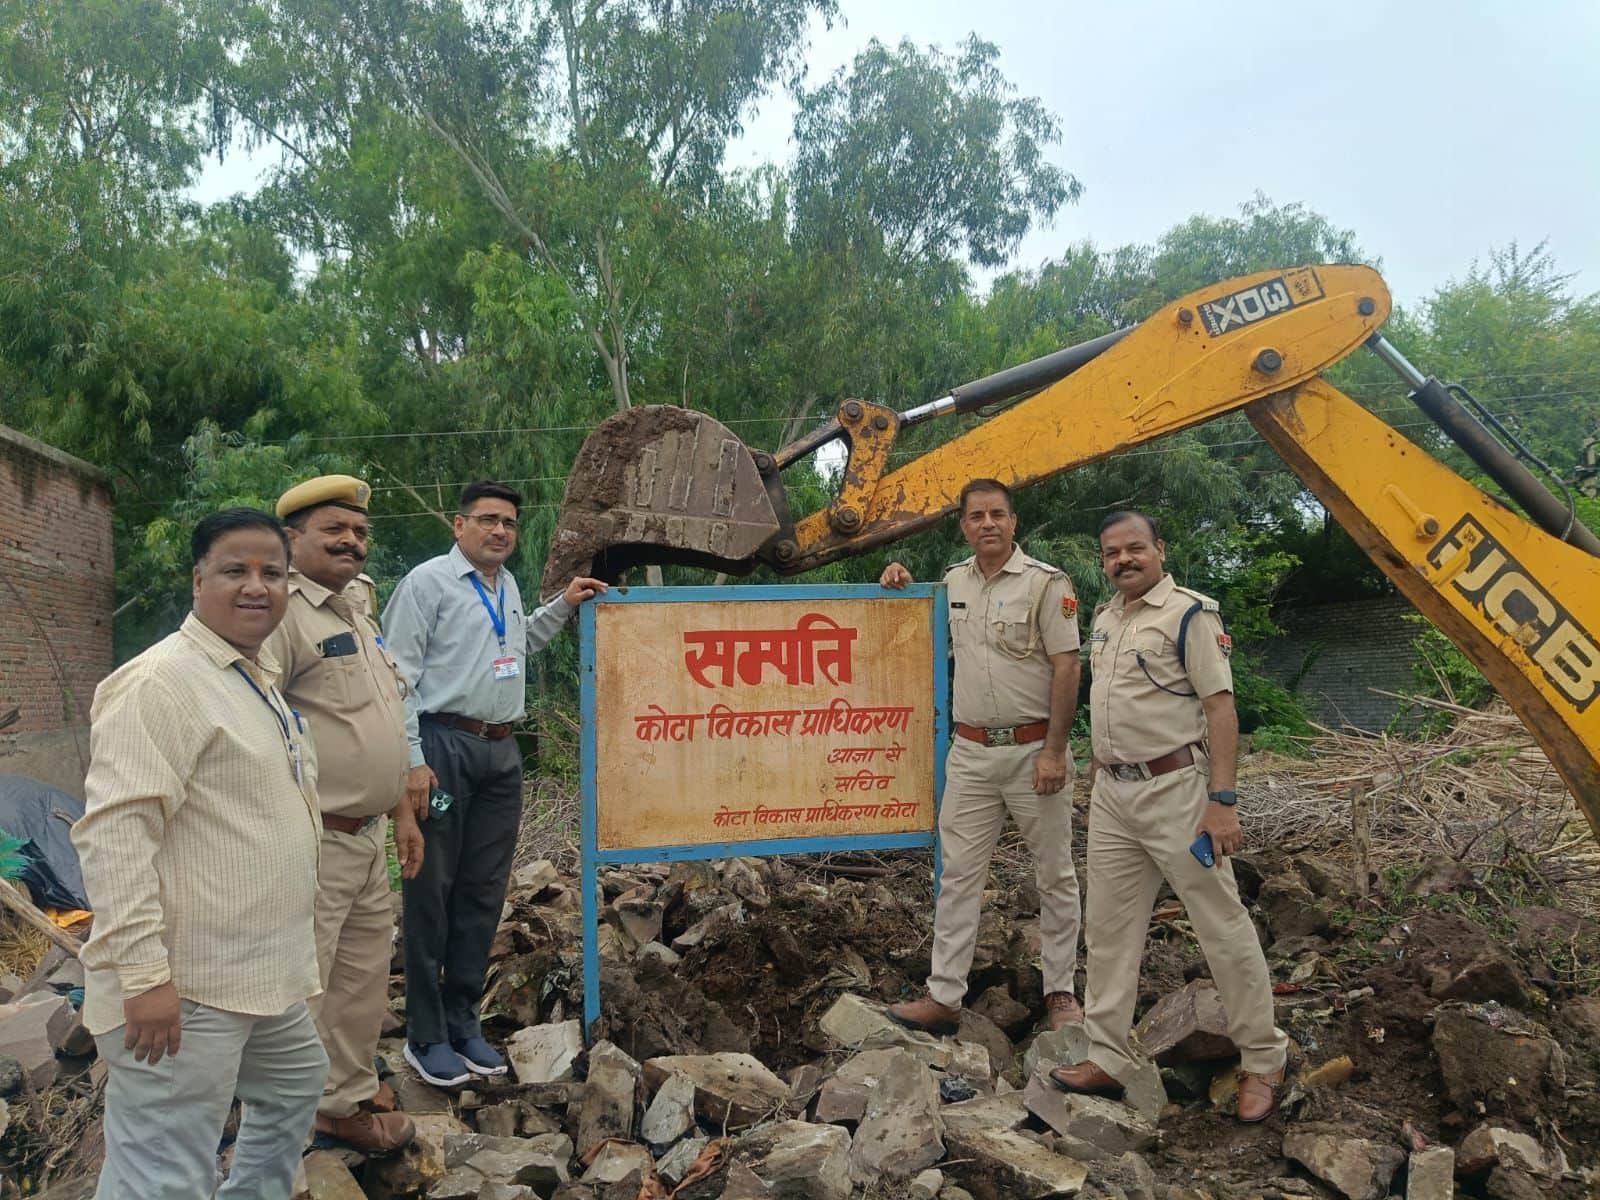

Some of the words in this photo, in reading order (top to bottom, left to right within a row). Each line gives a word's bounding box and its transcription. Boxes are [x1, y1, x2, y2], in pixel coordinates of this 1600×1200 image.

[1211, 281, 1290, 333] 3DX
[1432, 541, 1600, 701] JCB
[634, 704, 705, 742] कोटा
[706, 703, 801, 738] विकास
[800, 697, 914, 736] प्राधिकरण
[885, 741, 907, 762] से
[834, 769, 895, 792] सचिव
[713, 805, 750, 827] कोटा
[753, 804, 803, 825] विकास
[804, 799, 880, 823] प्राधिकरण
[880, 798, 920, 819] कोटा
